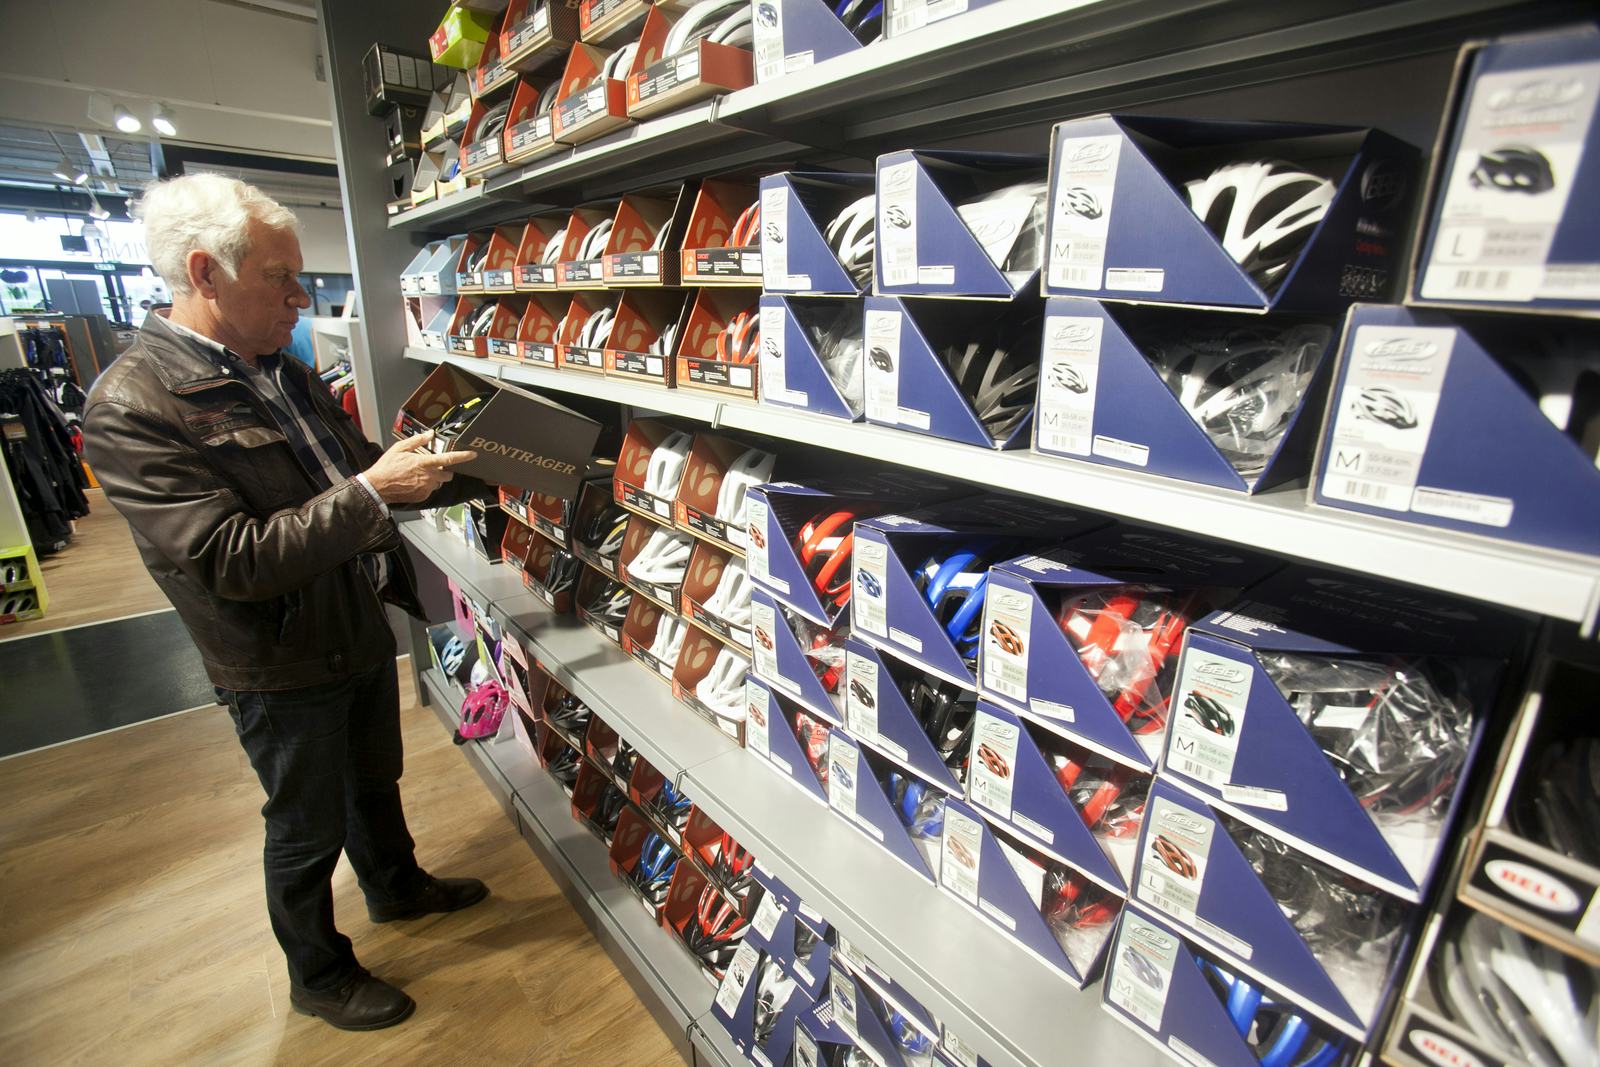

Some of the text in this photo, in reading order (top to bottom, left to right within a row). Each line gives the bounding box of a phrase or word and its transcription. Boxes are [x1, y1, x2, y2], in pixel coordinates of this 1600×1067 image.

[1054, 243, 1070, 259] M
[1450, 233, 1463, 257] L
[1043, 411, 1058, 426] M
[469, 436, 577, 475] BONTRAGER
[1336, 451, 1361, 470] M
[1176, 736, 1195, 754] M
[975, 777, 986, 790] M
[1149, 875, 1157, 888] L
[1500, 868, 1559, 901] BELL
[1117, 979, 1131, 996] M
